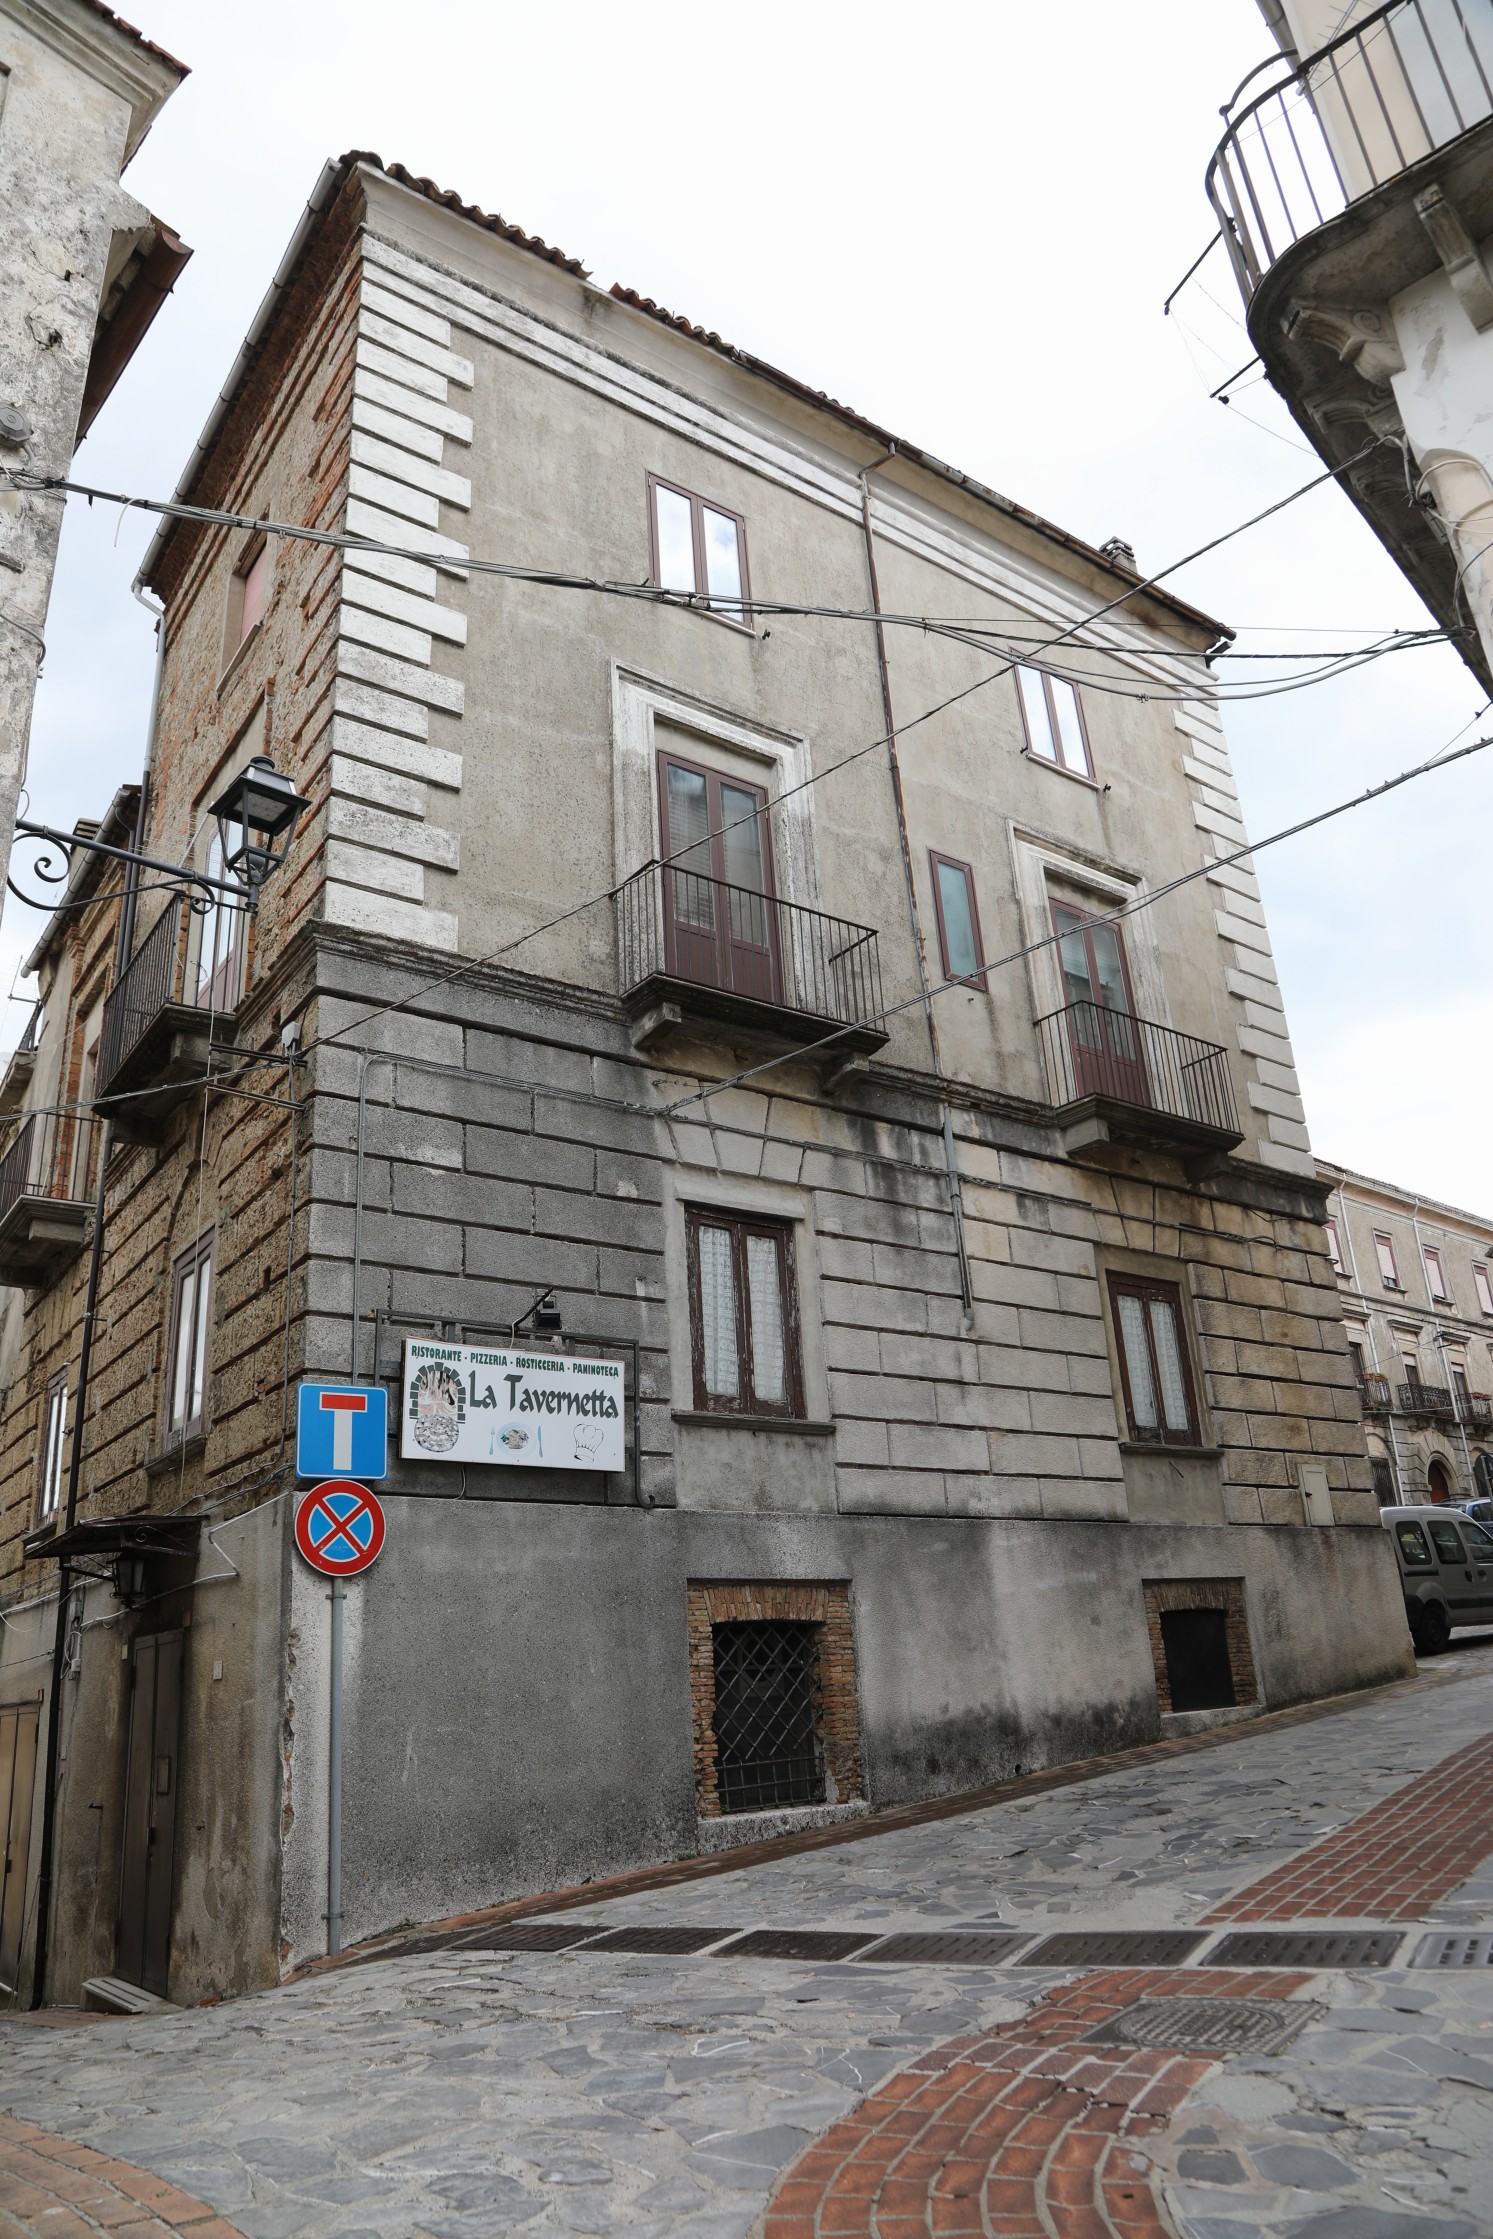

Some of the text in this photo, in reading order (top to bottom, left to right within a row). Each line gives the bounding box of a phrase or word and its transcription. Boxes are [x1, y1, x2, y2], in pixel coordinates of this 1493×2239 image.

[411, 1345, 619, 1378] RISTORANTE PIZZERIA ROSTICCERIA PANINOTECA
[468, 1369, 619, 1419] La Tavernetta
